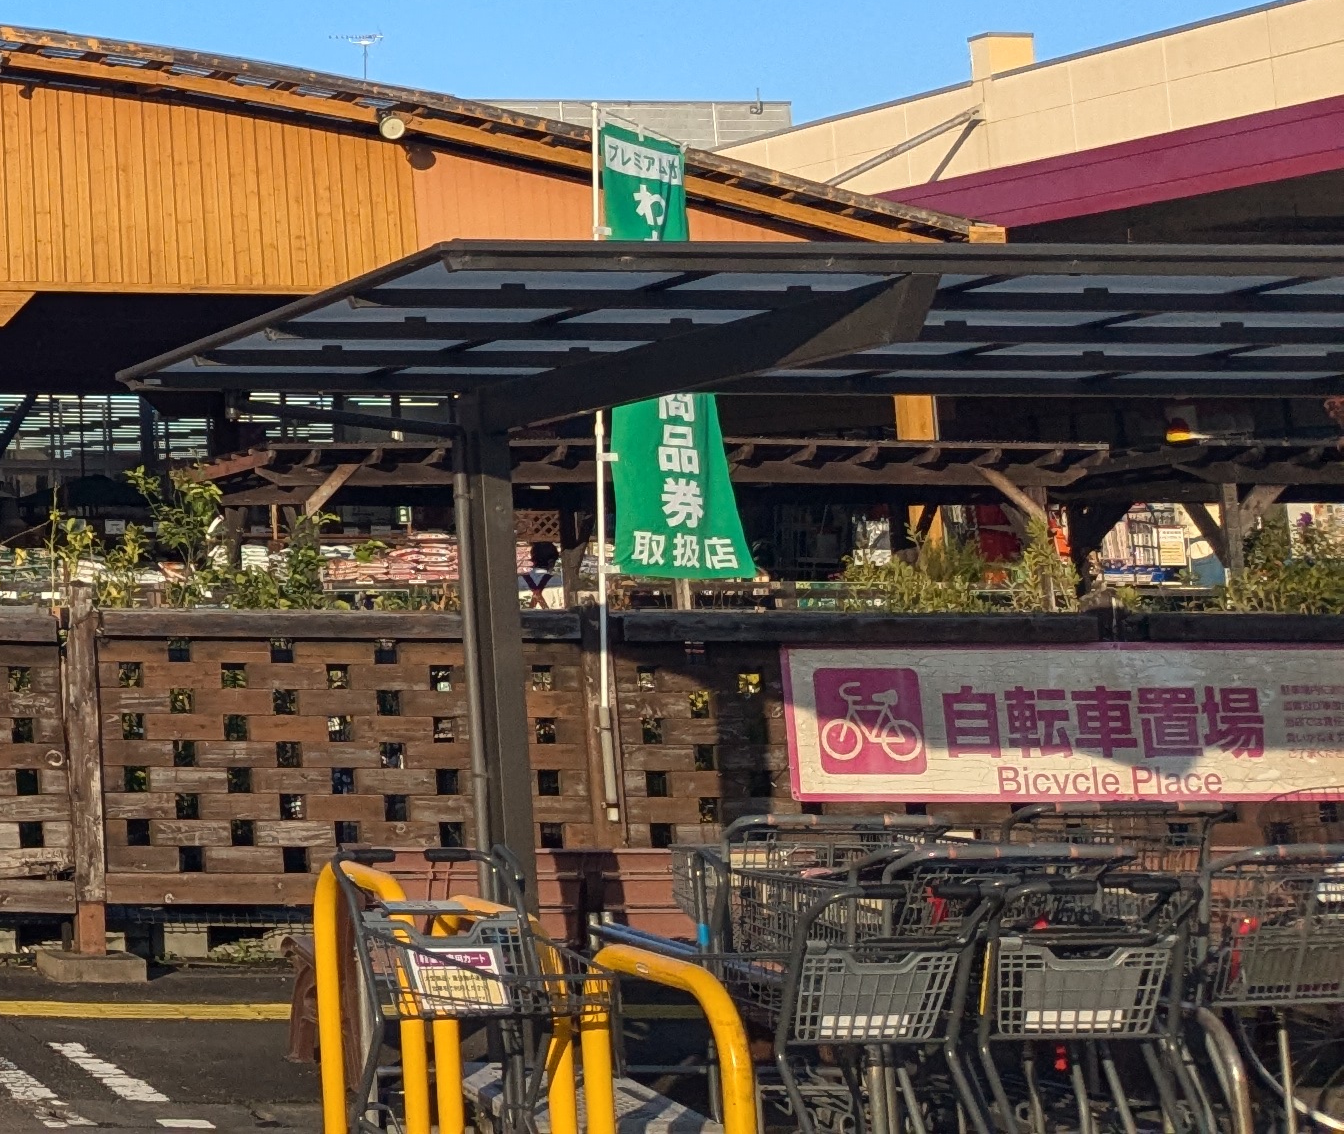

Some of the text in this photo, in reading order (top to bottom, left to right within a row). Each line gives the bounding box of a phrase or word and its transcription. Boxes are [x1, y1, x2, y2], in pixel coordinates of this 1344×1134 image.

[631, 530, 739, 570] 取扱店
[941, 685, 1266, 759] 自転車置場
[997, 765, 1223, 795] Bicycle Place
